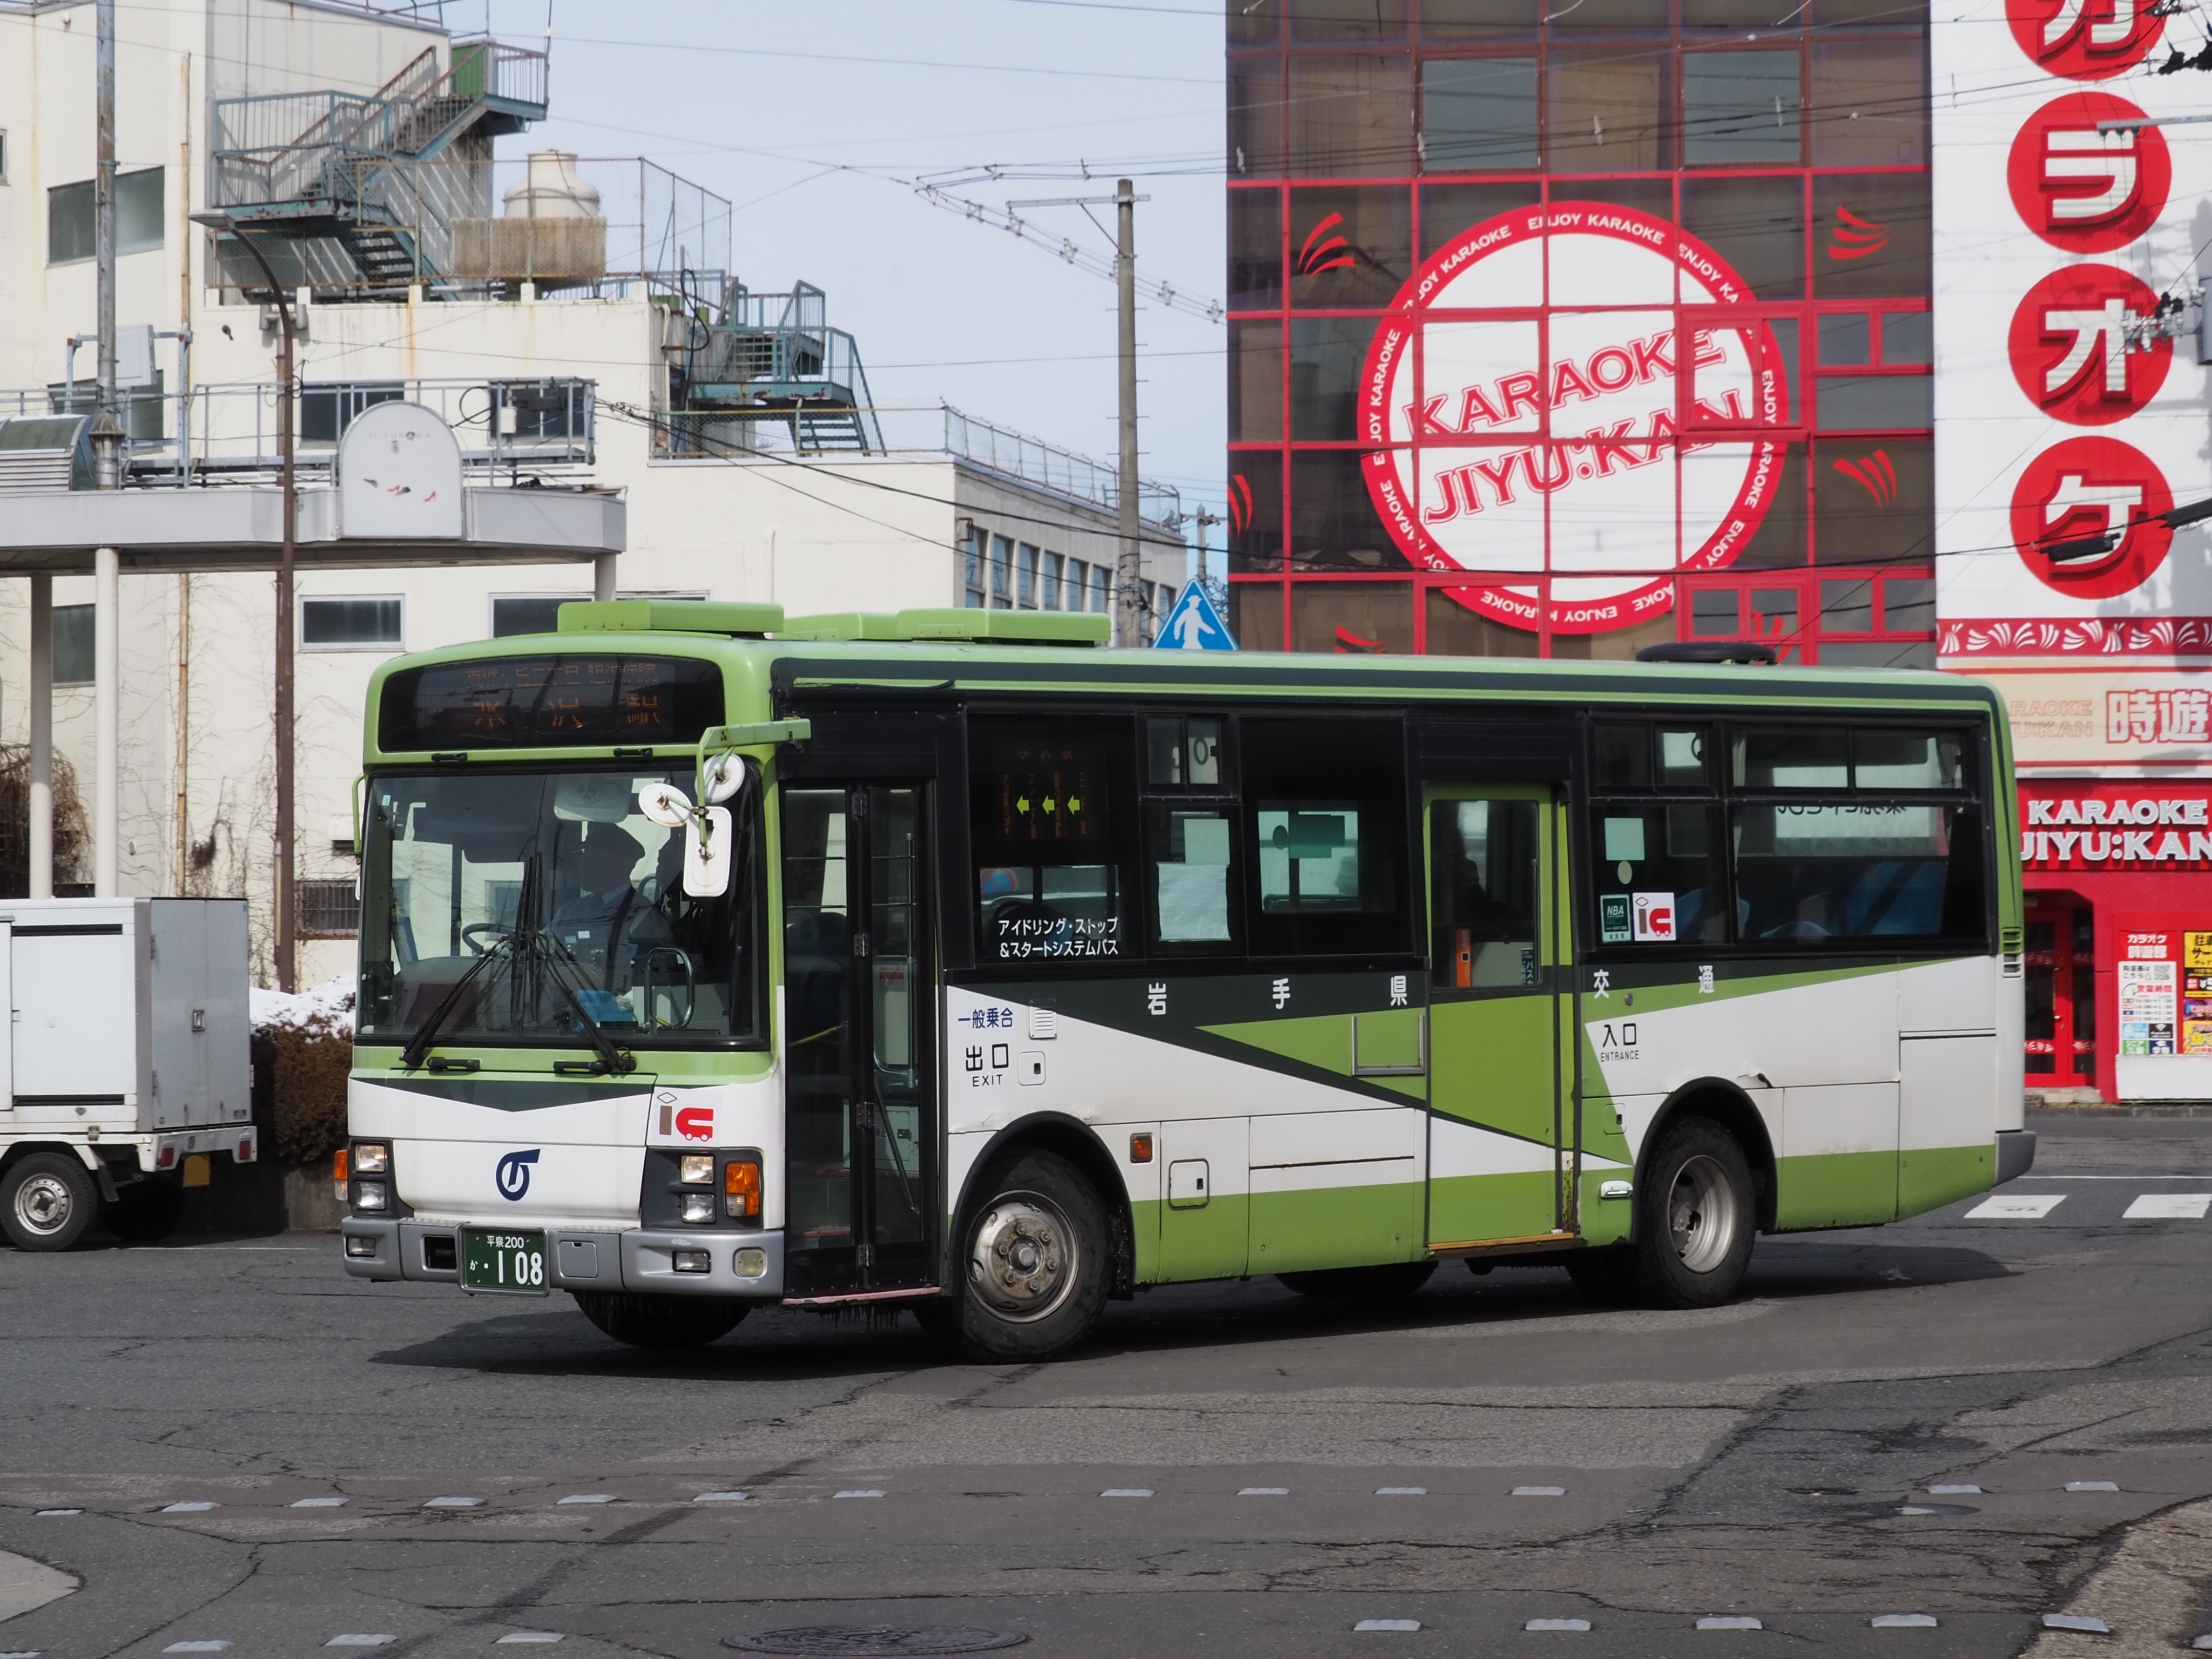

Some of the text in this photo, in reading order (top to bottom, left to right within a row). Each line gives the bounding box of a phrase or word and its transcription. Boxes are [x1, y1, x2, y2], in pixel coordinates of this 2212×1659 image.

[1587, 214, 1666, 245] KARAOKE
[1439, 224, 1512, 274] KARAOKE
[1369, 328, 1401, 467] EJOY KARAOKE
[1744, 441, 1775, 509] ARAOKE
[1705, 519, 1746, 567] ENJOY
[1563, 605, 1618, 622] ENJOY
[2008, 700, 2093, 717] RAOKE
[2106, 689, 2212, 745] 時遊
[2028, 799, 2208, 826] KARAOKE
[1607, 905, 1624, 916] NBA
[998, 916, 1119, 935] アイドリング・ストップ
[999, 940, 1119, 958] &スタートシステムバス
[957, 1007, 1014, 1029] 一般乗合
[1602, 1023, 1637, 1048] 入口
[966, 1043, 1009, 1072] 出口
[1600, 1050, 1639, 1062] ENTRANCE
[972, 1074, 1003, 1087] EXIT
[487, 1235, 524, 1249] 平泉200
